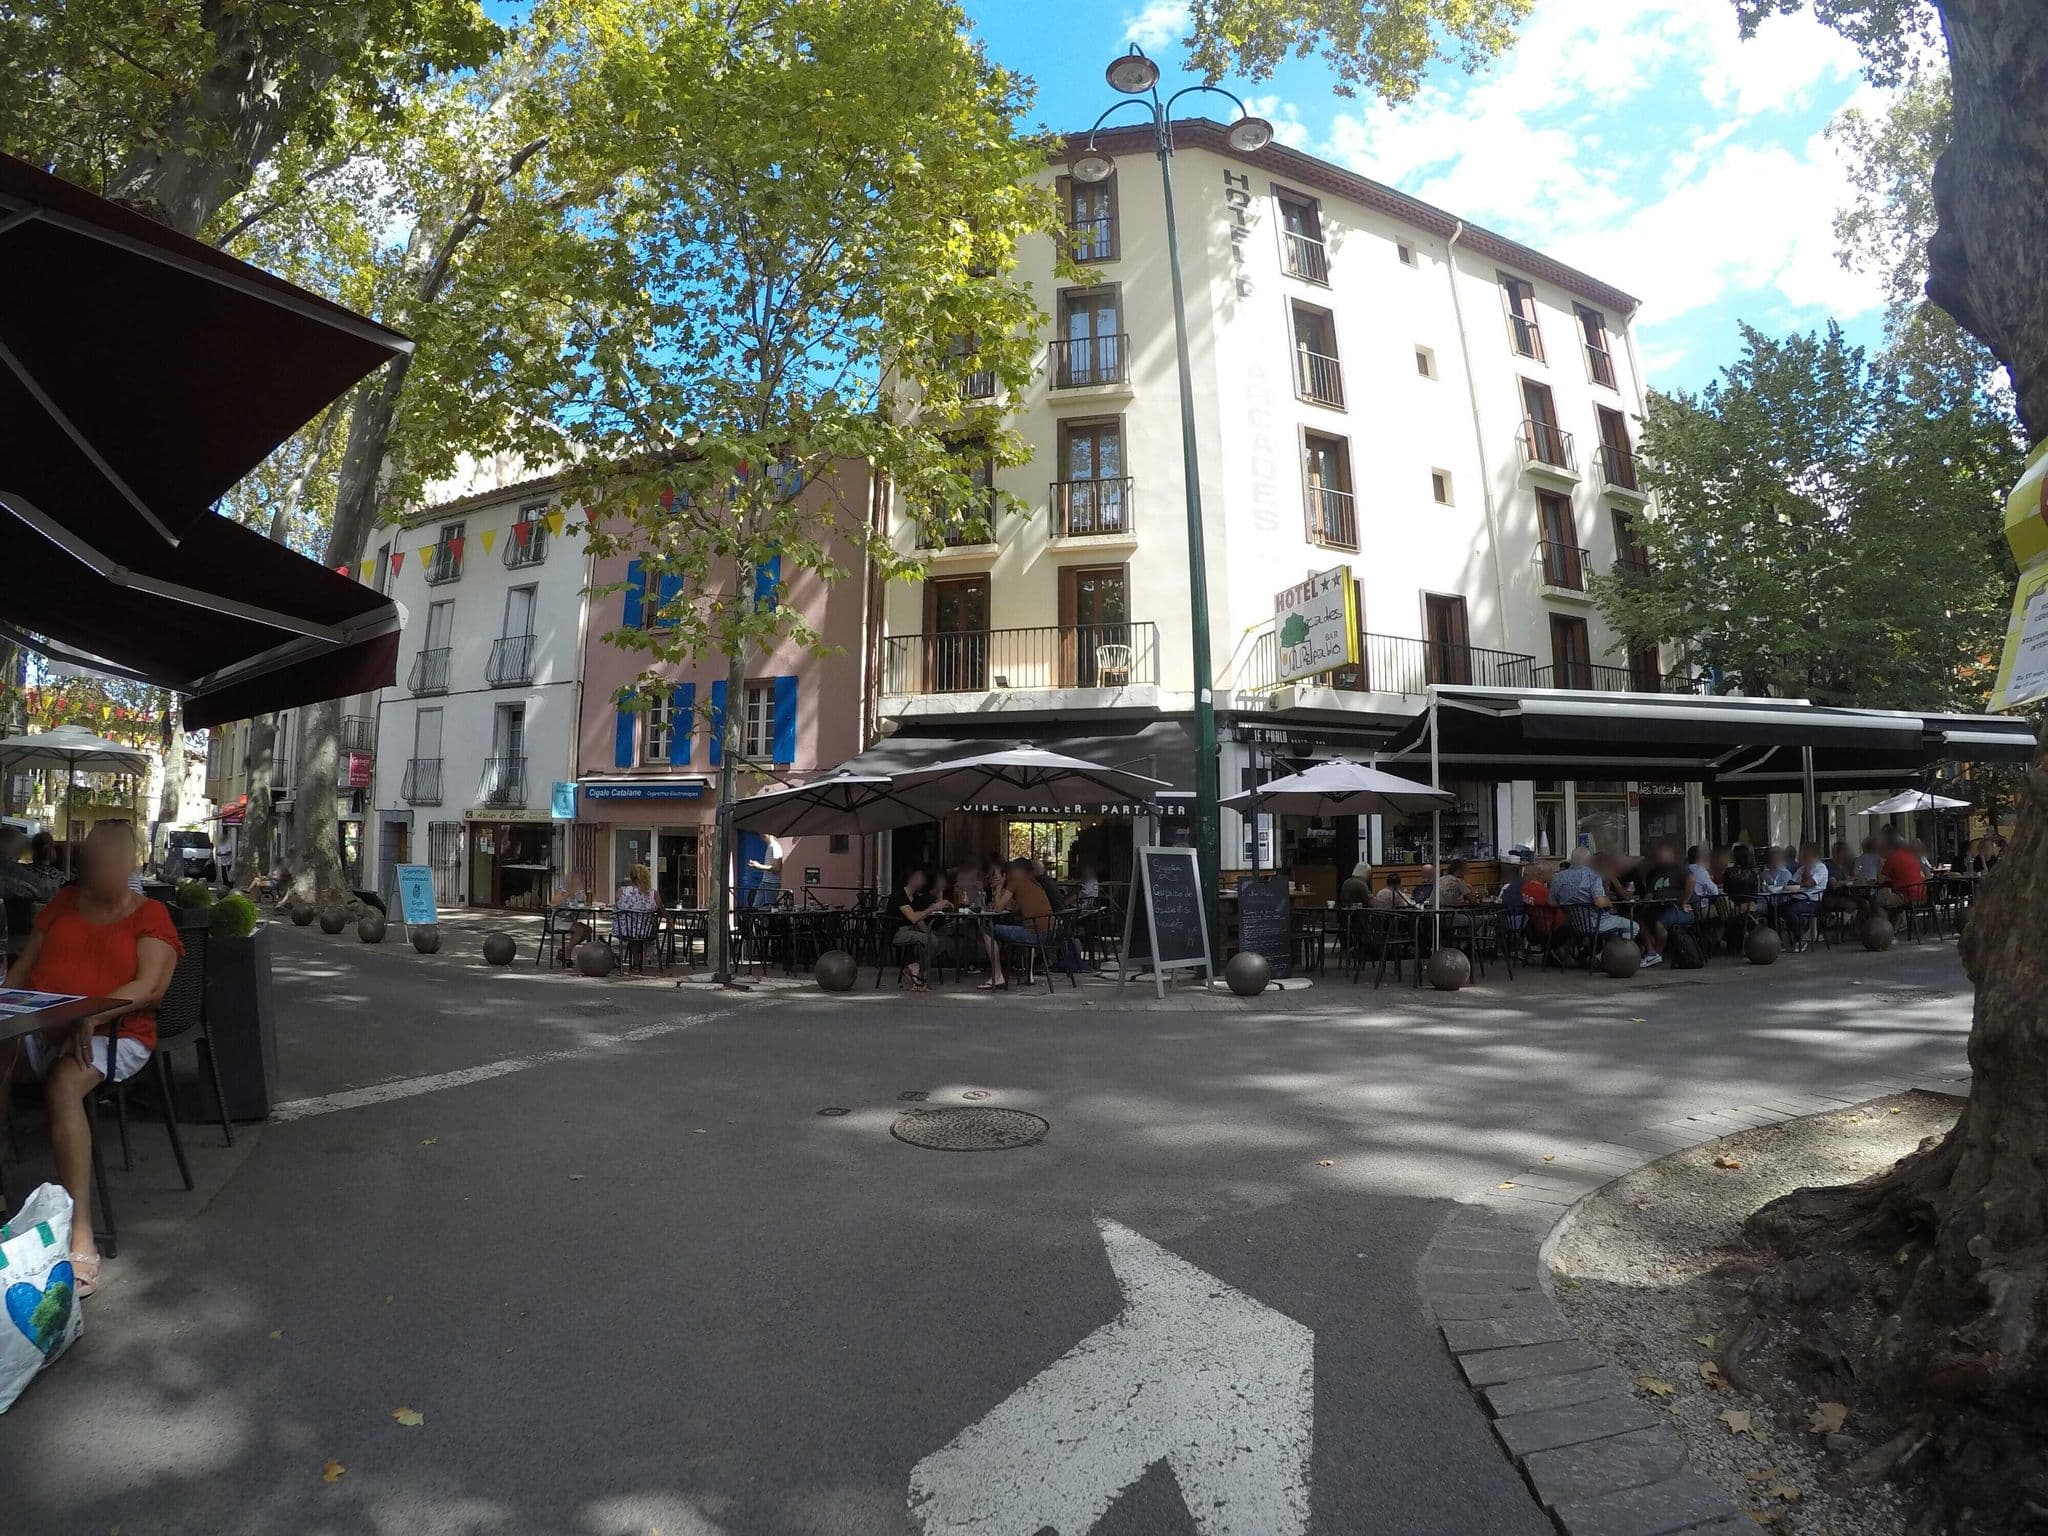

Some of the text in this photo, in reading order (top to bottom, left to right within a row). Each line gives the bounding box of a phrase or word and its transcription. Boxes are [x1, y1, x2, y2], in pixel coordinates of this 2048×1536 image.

[1276, 577, 1319, 614] HOTEL
[1325, 630, 1338, 641] BAR
[1254, 729, 1263, 742] LE
[588, 788, 610, 799] Cigale
[611, 788, 642, 798] Catalane
